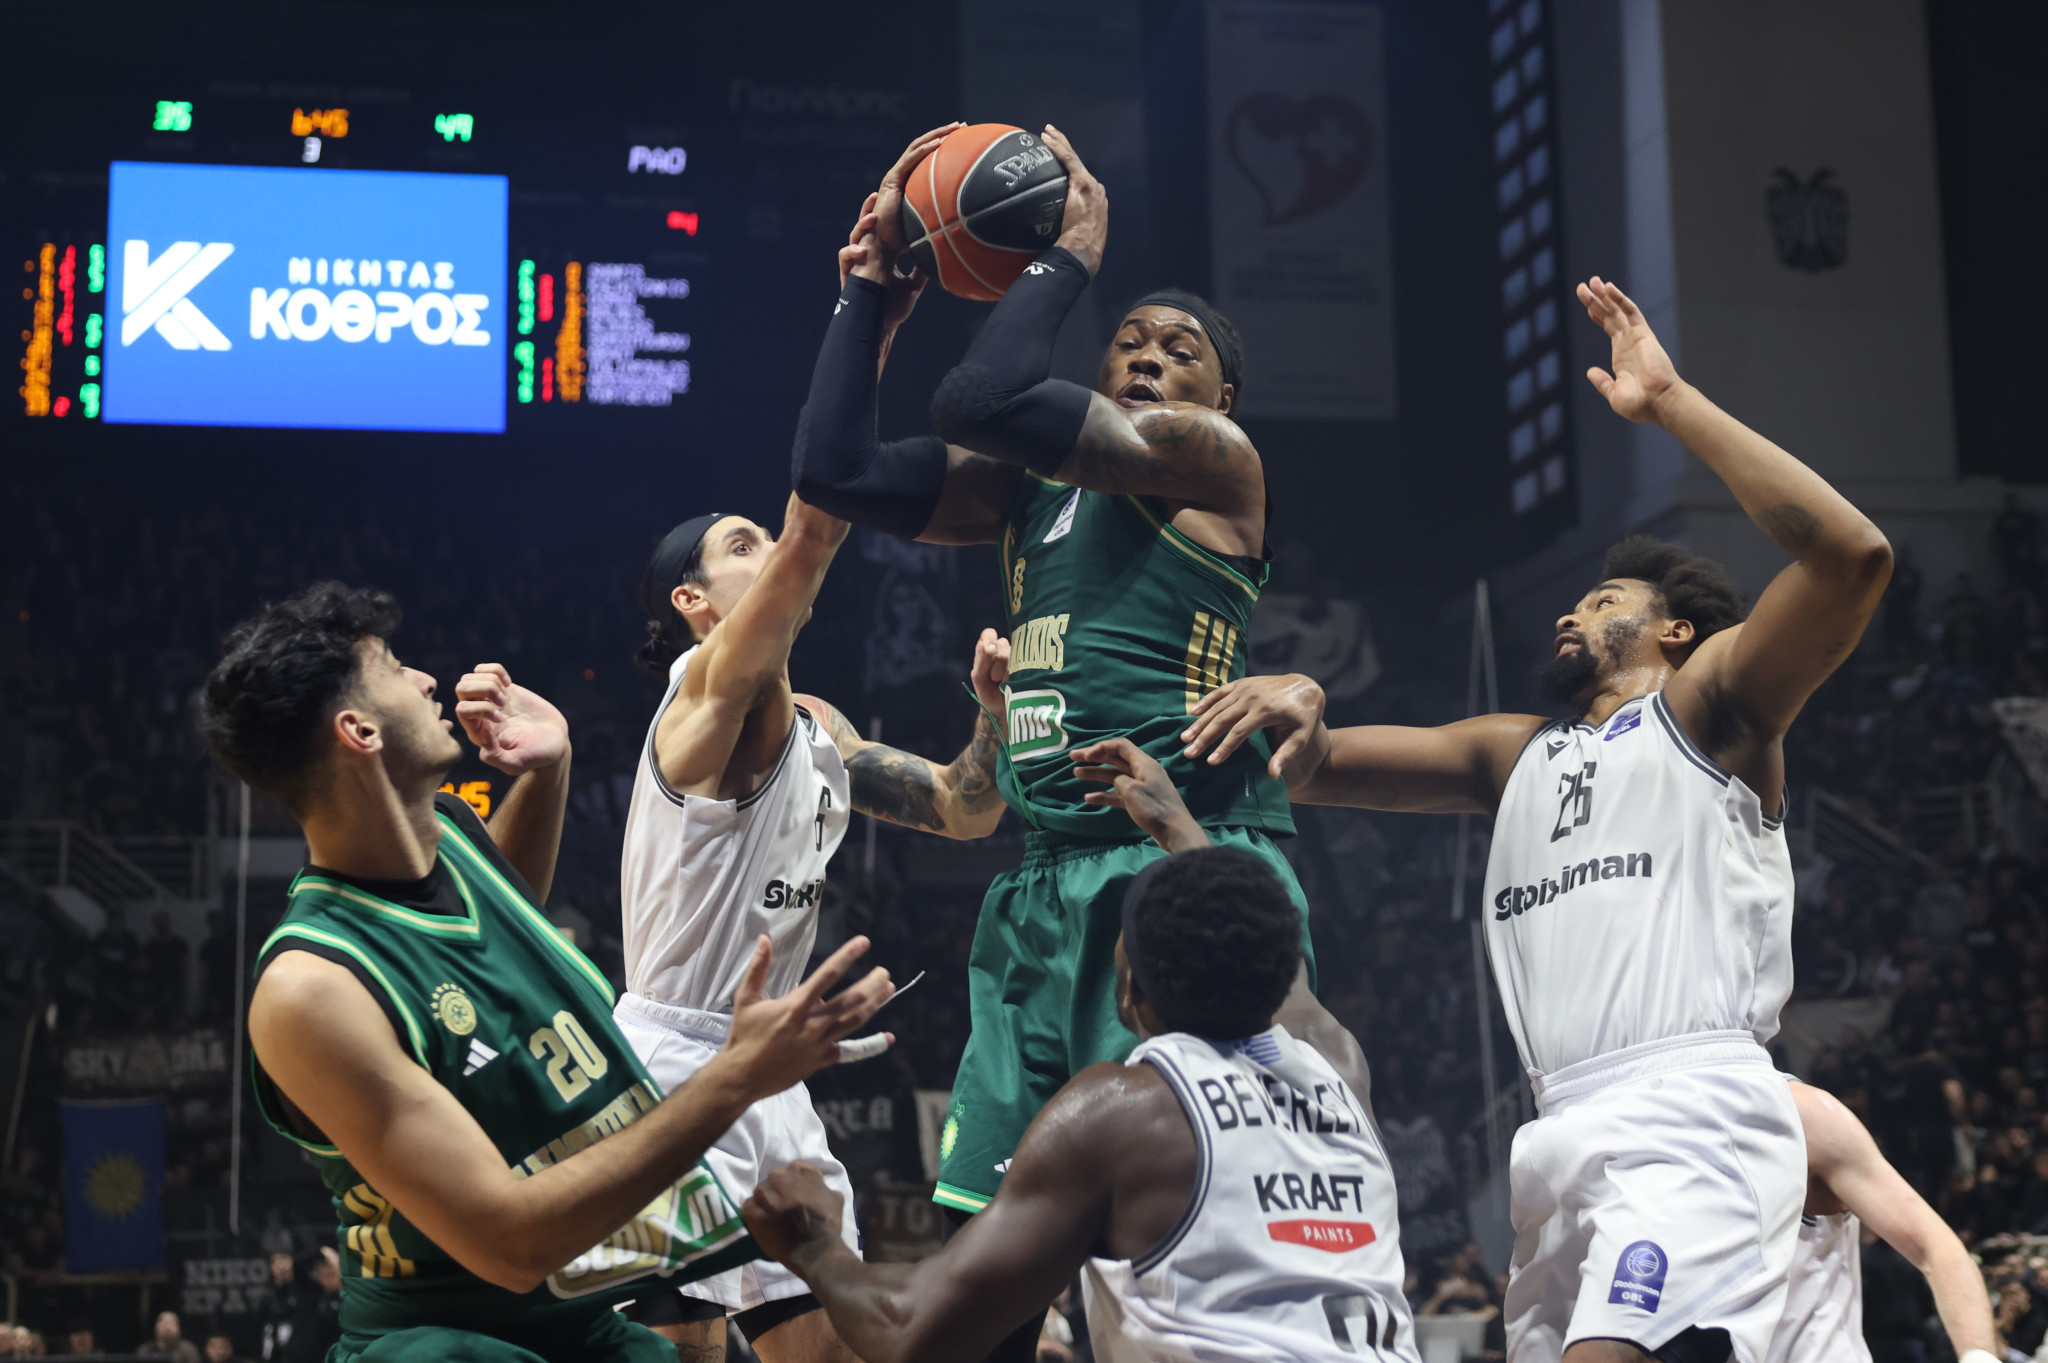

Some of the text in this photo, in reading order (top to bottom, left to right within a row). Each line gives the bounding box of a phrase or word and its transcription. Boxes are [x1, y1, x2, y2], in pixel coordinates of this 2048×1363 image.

[250, 286, 491, 346] ΚΟΘΡΟΣ
[1494, 852, 1653, 921] Stoiximan
[529, 1010, 608, 1103] 20
[1253, 1172, 1365, 1214] KRAFT
[1304, 1224, 1354, 1243] PAINTS
[1621, 1291, 1646, 1304] GBL
